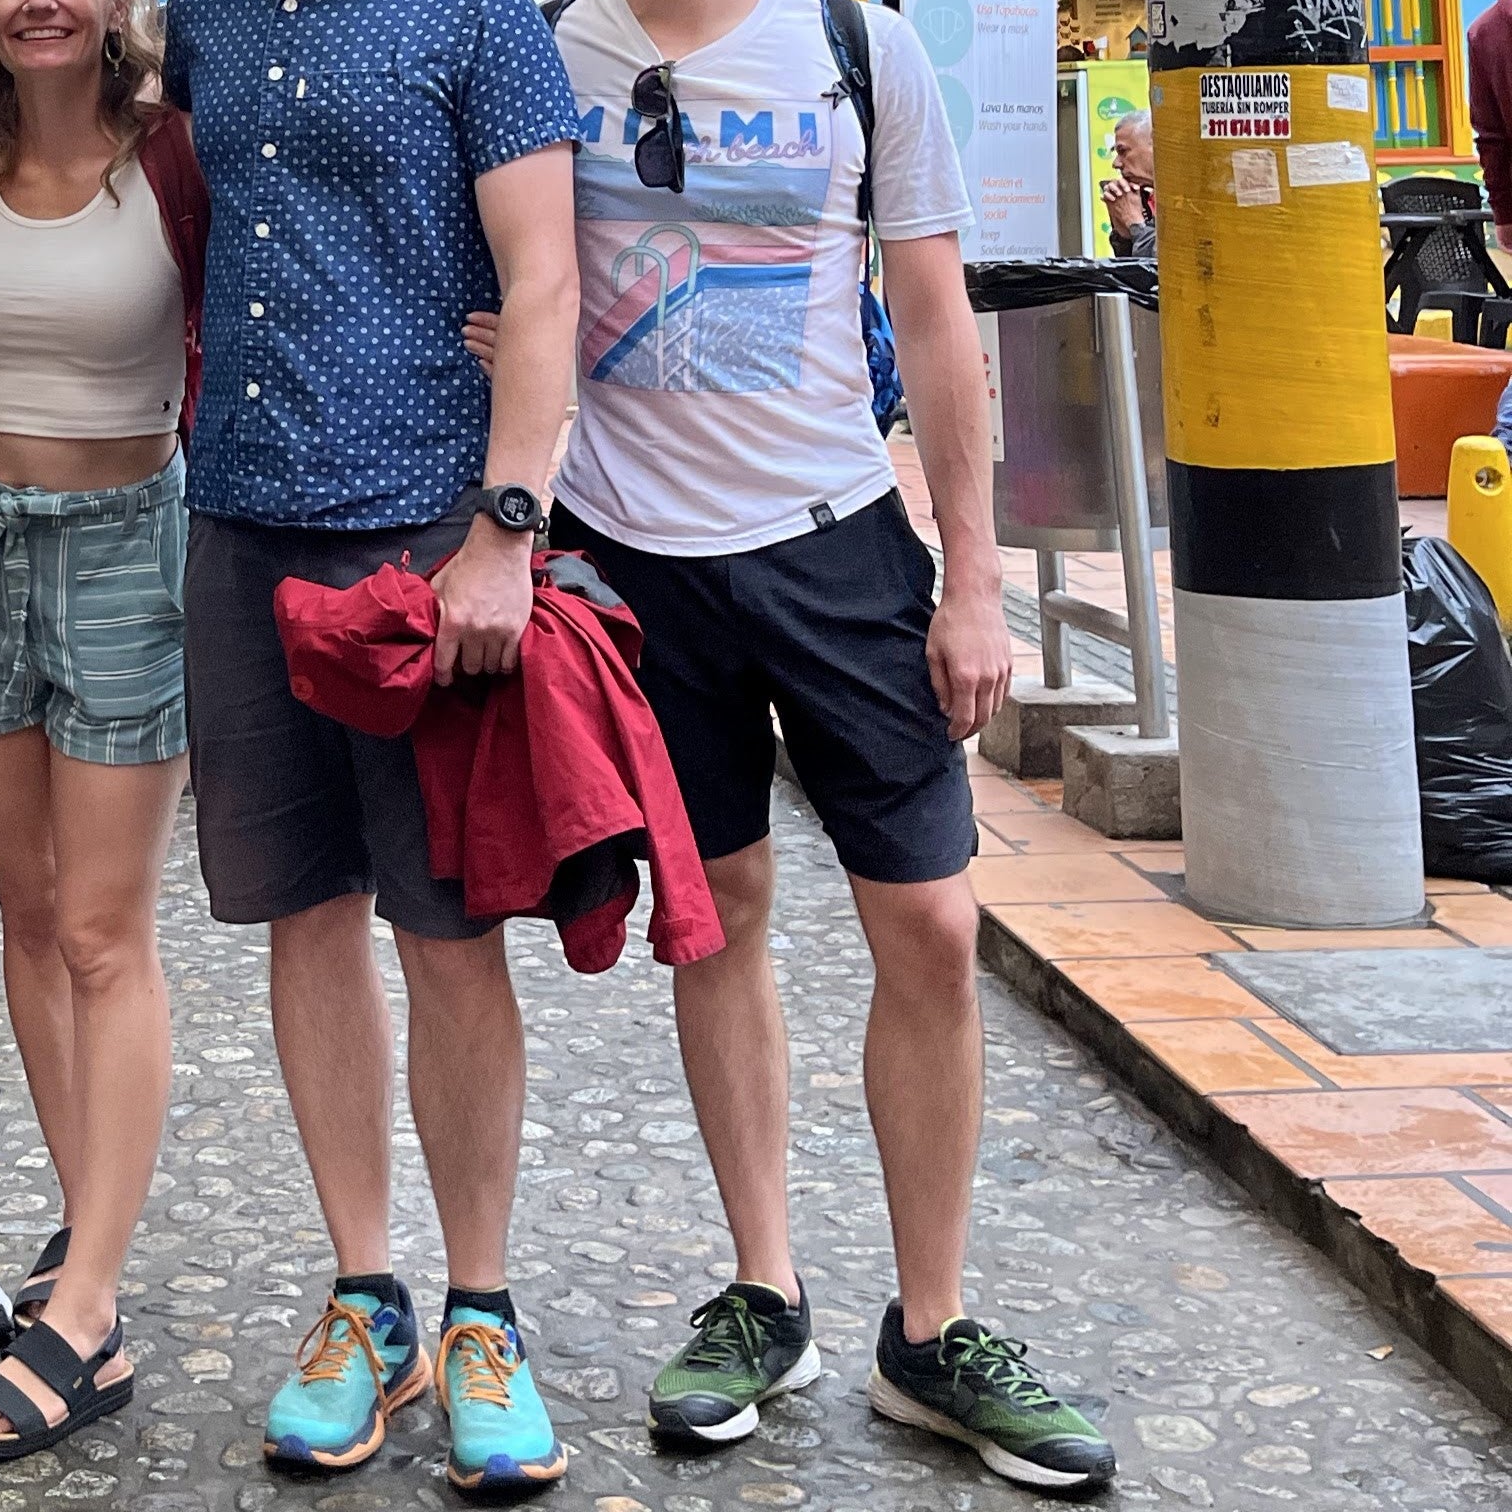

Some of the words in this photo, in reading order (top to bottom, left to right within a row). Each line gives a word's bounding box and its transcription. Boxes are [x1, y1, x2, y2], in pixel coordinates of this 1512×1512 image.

[977, 22, 999, 33] Wear
[1007, 24, 1029, 34] mask
[1201, 73, 1289, 100] DESTAQUIAMOS
[981, 102, 1001, 113] Lava
[1016, 104, 1044, 115] manos
[1237, 101, 1251, 114] SIN
[1253, 101, 1290, 114] ROMPER
[979, 120, 1001, 131] Wash
[1002, 122, 1022, 134] your
[1023, 121, 1048, 132] hands
[726, 128, 825, 163] beach
[984, 209, 1008, 221] social
[980, 244, 1006, 256] Social
[1007, 245, 1048, 257] distancing
